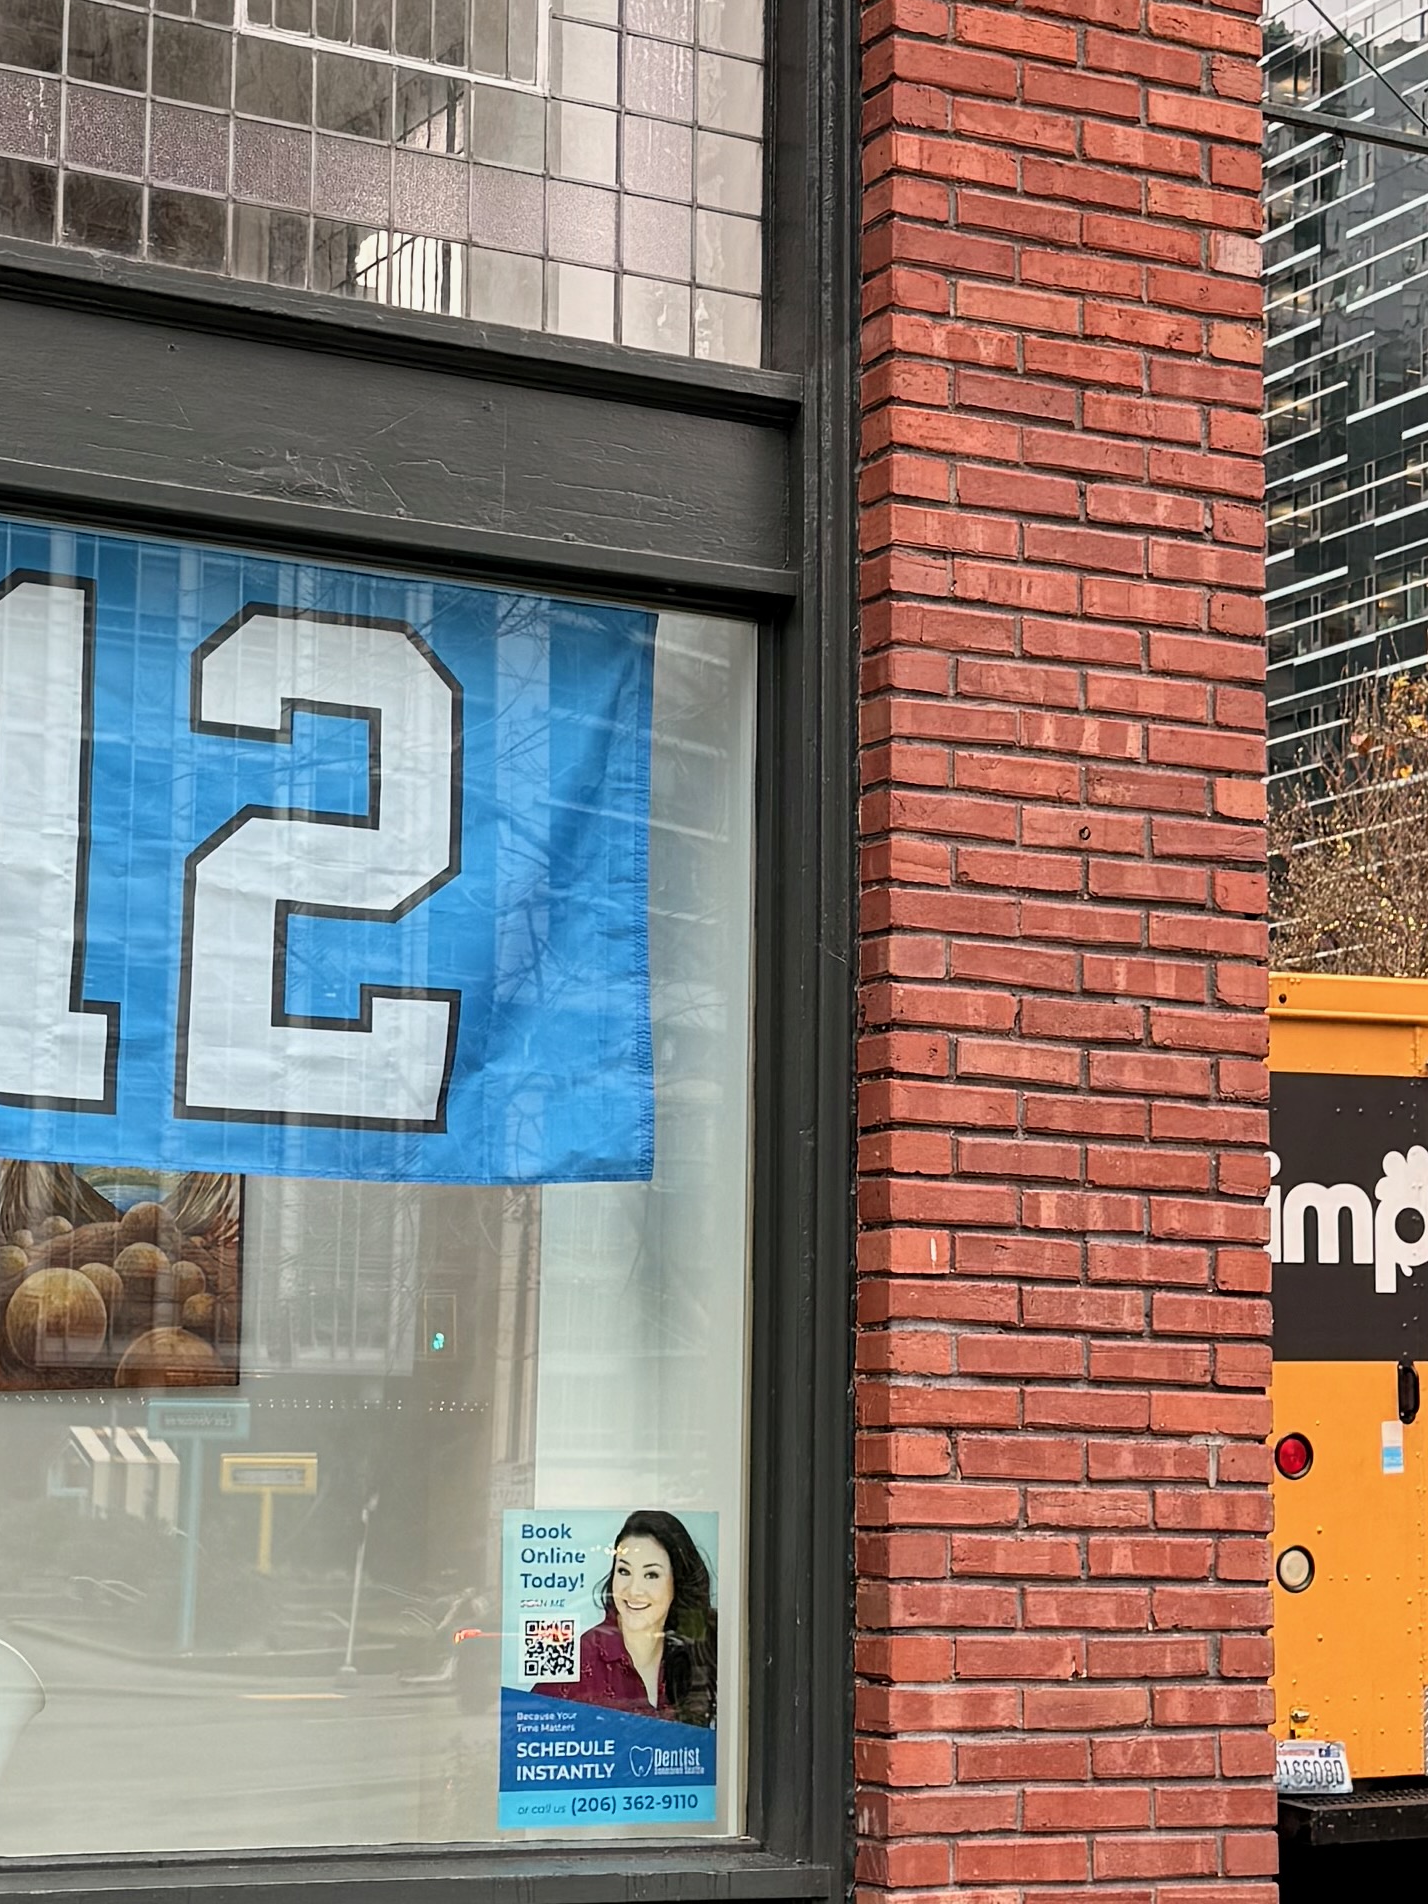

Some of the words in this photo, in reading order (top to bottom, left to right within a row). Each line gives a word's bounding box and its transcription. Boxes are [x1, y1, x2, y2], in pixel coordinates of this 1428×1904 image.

[521, 1523, 572, 1539] Book
[521, 1547, 586, 1564] Online
[520, 1572, 585, 1593] Today!
[516, 1712, 555, 1721] Because
[556, 1711, 578, 1721] Your
[516, 1724, 539, 1733] Time
[540, 1723, 576, 1733] Matters
[516, 1739, 615, 1758] SCHEDULE
[653, 1747, 701, 1767] Dentist
[516, 1762, 616, 1782] INSTANTLY
[517, 1806, 529, 1815] or
[553, 1806, 566, 1815] us
[571, 1795, 617, 1817] (206)
[622, 1793, 699, 1811] 362-9110
